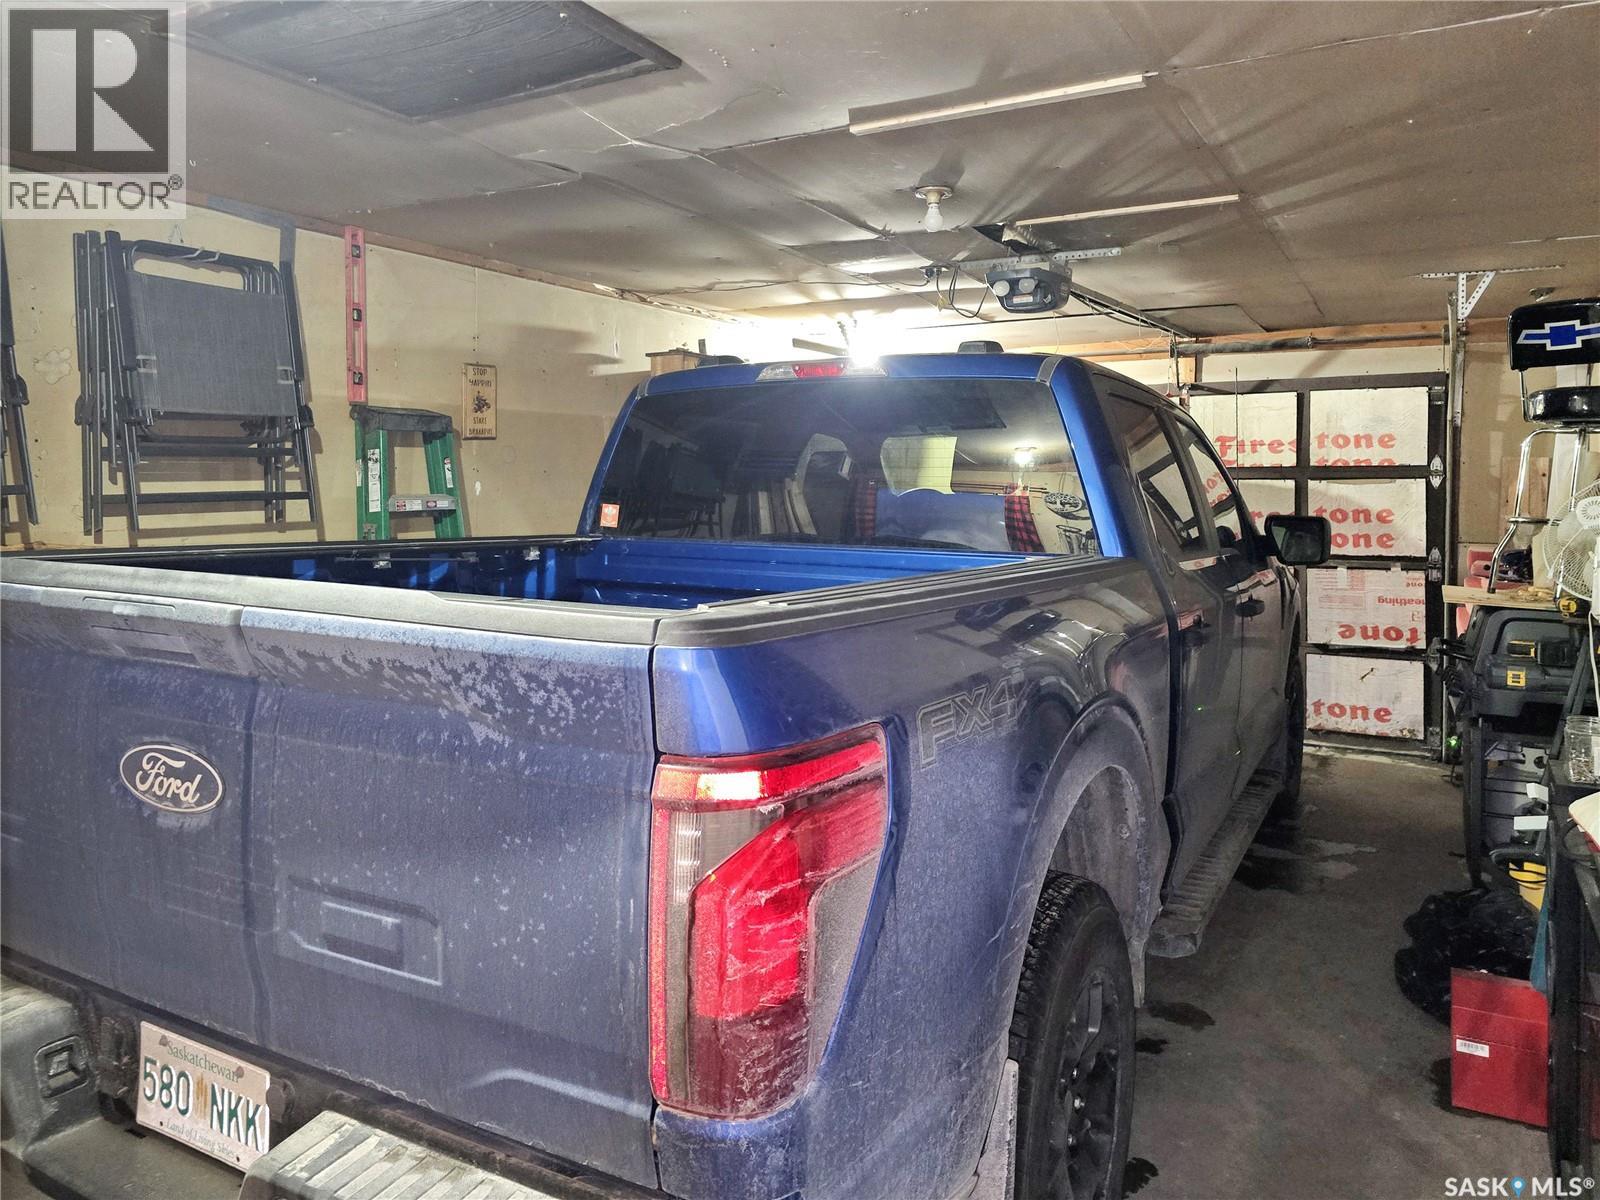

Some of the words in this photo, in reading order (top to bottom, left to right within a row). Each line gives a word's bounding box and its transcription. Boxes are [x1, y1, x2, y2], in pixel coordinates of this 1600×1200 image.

[472, 367, 488, 377] STOP
[1313, 431, 1397, 449] tone
[1312, 505, 1395, 524] tone
[1331, 532, 1395, 549] one
[1338, 624, 1421, 645] tone
[1310, 698, 1393, 723] tone
[916, 675, 1018, 772] FX4
[135, 752, 203, 804] Ford
[167, 1040, 239, 1083] Saskatchewan
[143, 1055, 193, 1117] 580
[210, 1082, 264, 1153] NKK
[166, 1118, 185, 1134] Land
